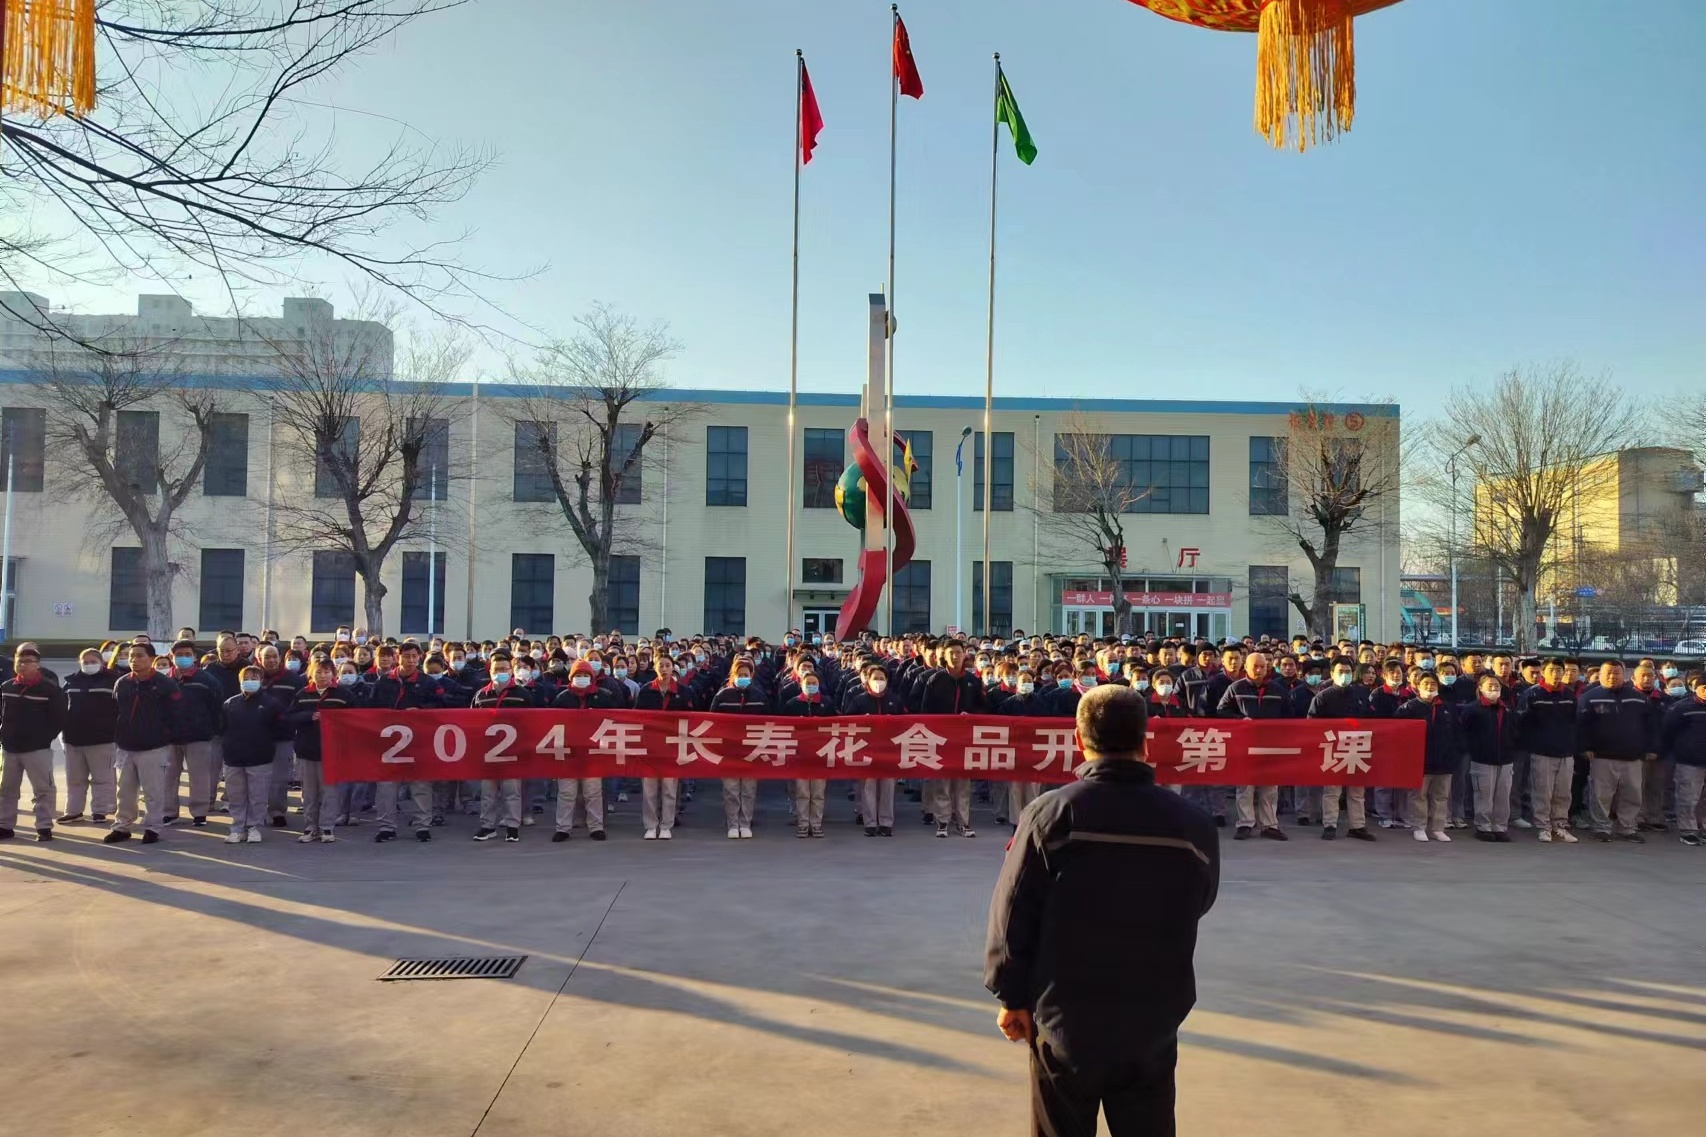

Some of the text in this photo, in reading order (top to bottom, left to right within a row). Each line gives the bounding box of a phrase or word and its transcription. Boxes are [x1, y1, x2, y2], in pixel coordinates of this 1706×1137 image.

[380, 719, 1373, 775] 2024年长寿花食品开第一课
